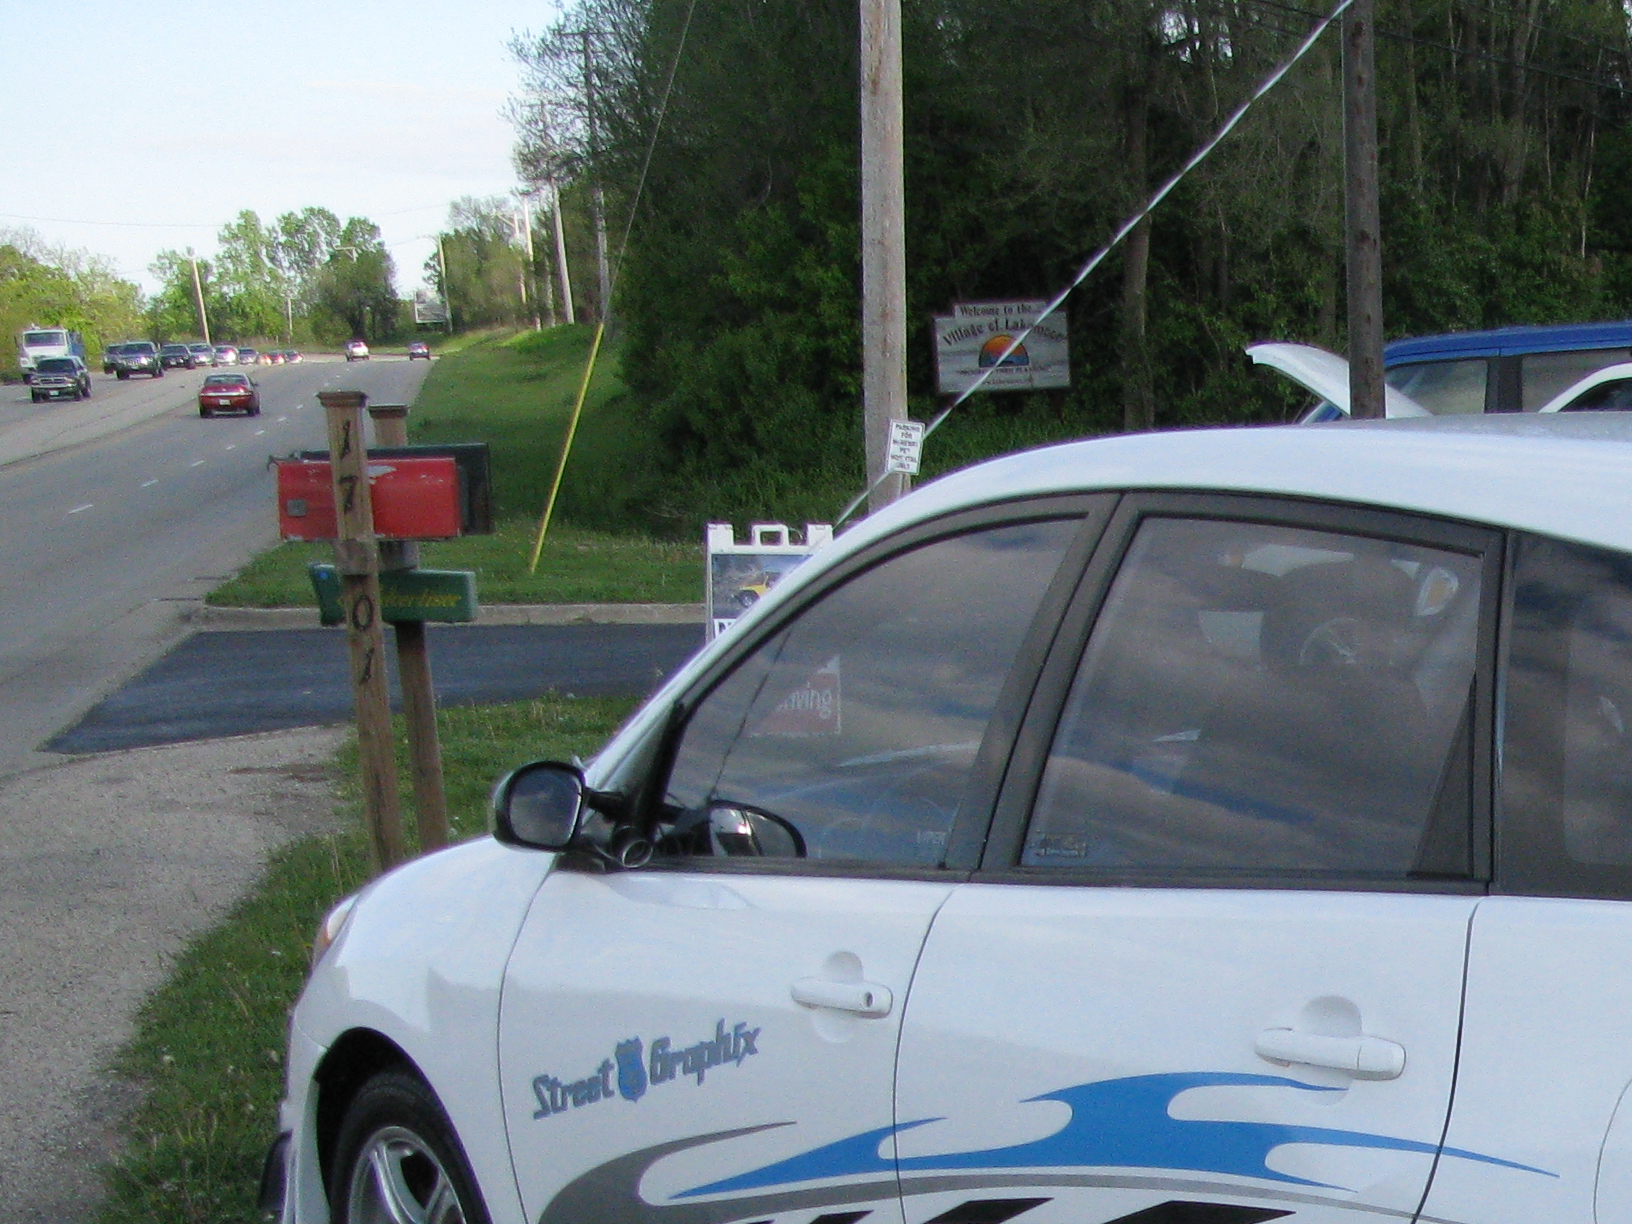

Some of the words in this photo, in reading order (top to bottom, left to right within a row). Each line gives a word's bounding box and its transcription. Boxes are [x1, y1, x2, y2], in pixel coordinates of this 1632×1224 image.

[960, 304, 1000, 317] Welcome
[1004, 303, 1014, 315] to
[943, 323, 984, 346] Village
[533, 1057, 616, 1120] Street
[650, 1018, 762, 1086] Graphix
